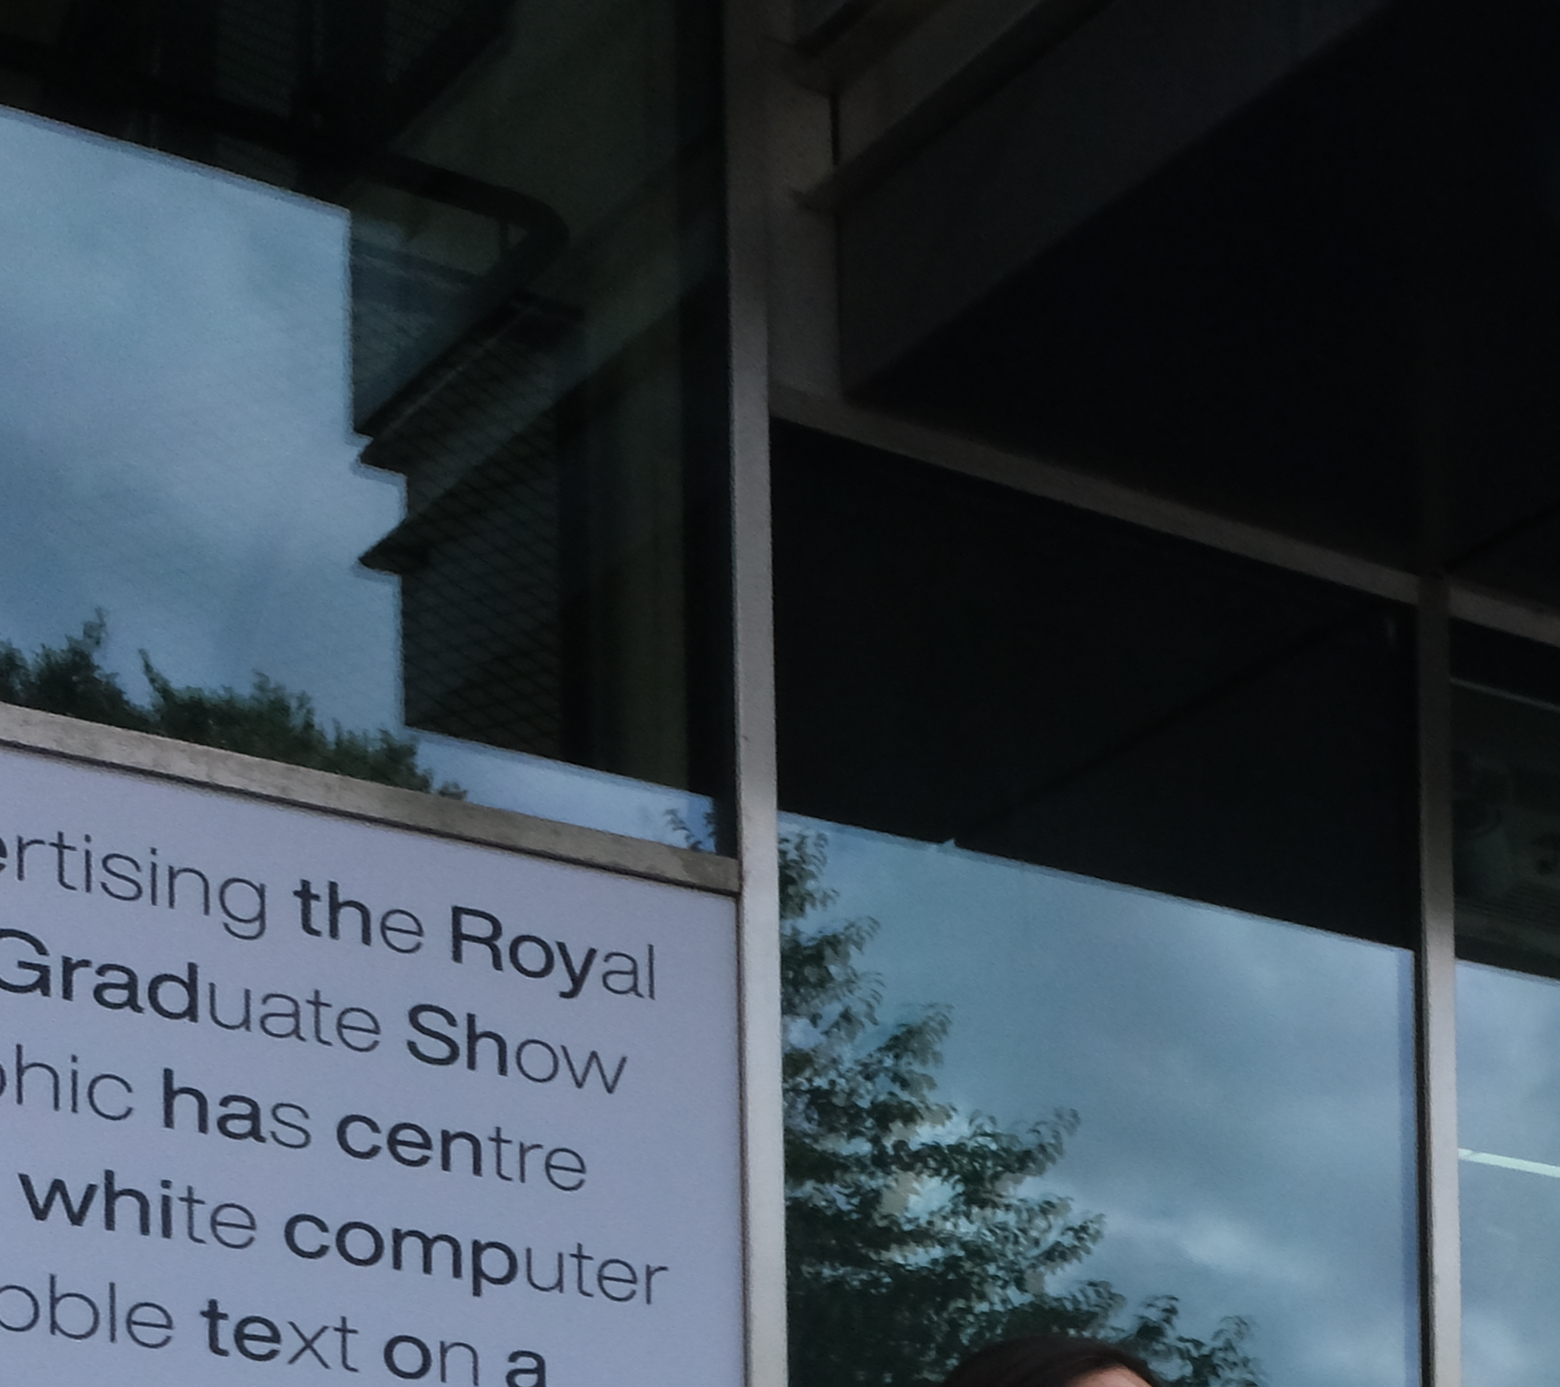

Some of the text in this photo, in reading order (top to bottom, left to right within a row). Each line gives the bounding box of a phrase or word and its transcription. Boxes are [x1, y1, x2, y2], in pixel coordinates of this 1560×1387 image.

[0, 830, 656, 1000] rtising the Royal
[0, 929, 628, 1095] Graduate Show
[0, 1044, 588, 1192] hic has centre
[18, 1169, 670, 1305] white computer
[0, 1274, 175, 1350] oble
[200, 1298, 360, 1373] text
